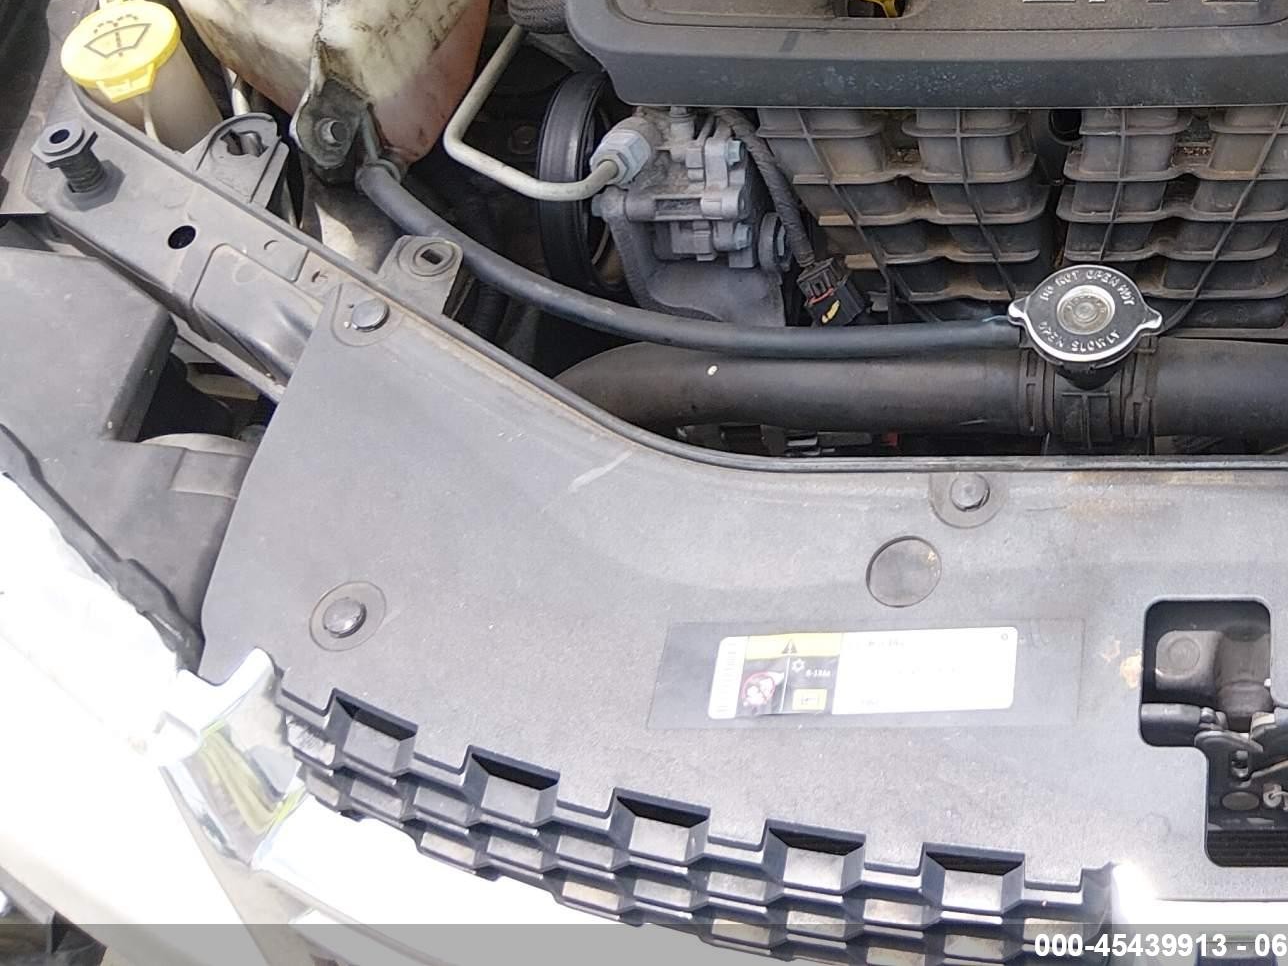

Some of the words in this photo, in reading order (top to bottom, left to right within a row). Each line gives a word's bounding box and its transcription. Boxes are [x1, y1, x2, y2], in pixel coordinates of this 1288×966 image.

[1039, 285, 1056, 302] DO
[1054, 269, 1081, 287] NOT
[1085, 269, 1120, 288] OPEN
[1116, 283, 1137, 307] HOT
[1038, 320, 1065, 348] OPEN
[1071, 328, 1122, 353] SLOWLY
